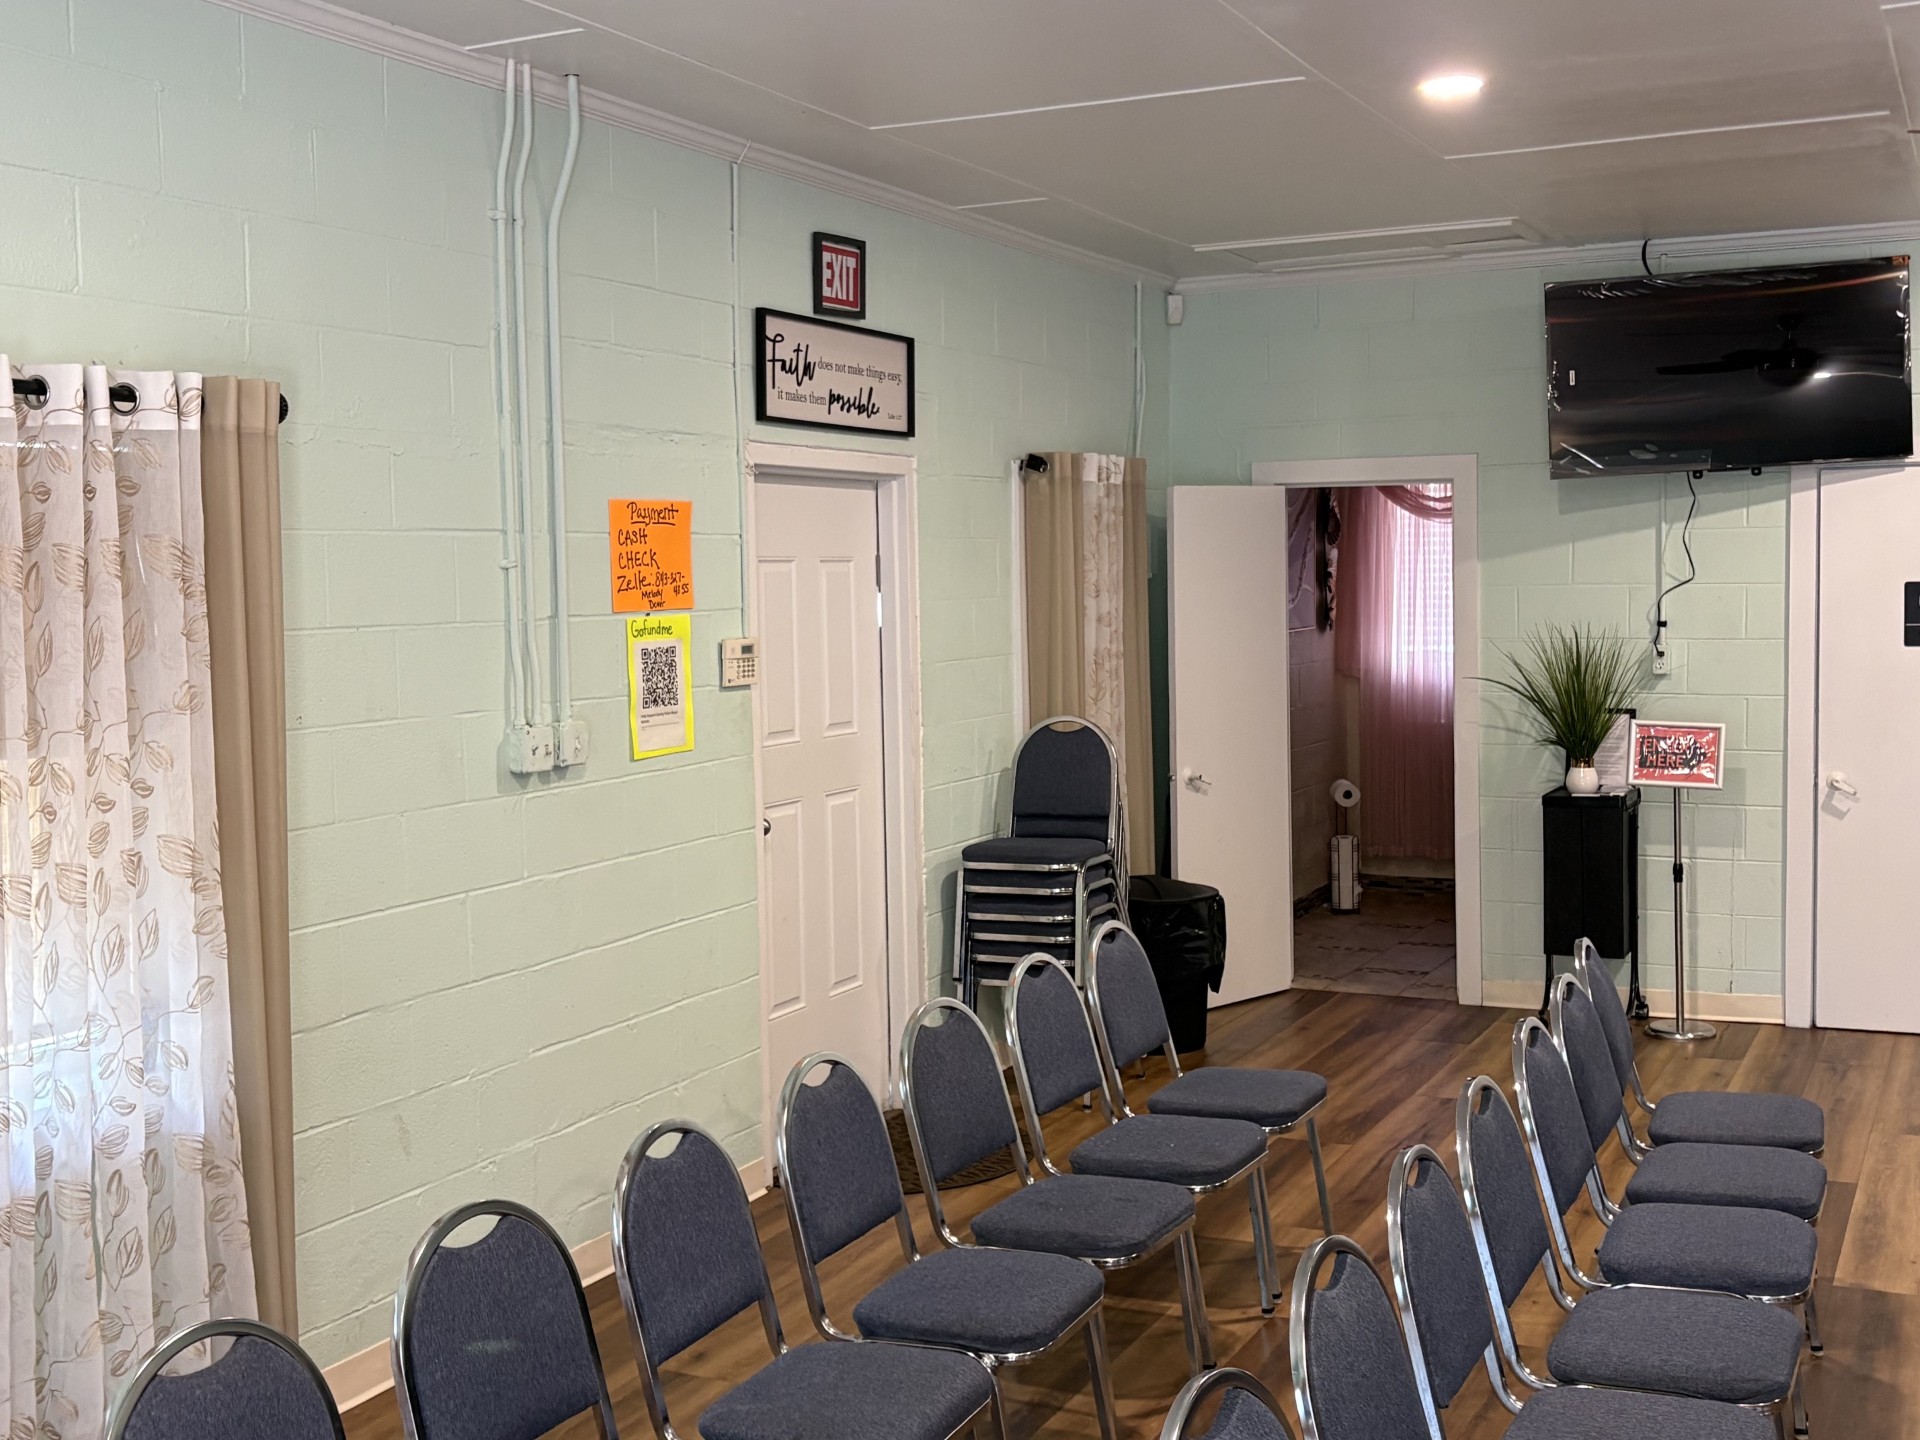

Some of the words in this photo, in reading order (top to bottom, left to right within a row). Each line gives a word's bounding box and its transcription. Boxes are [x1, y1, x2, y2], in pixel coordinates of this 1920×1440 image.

[822, 251, 857, 302] EXIT
[765, 333, 816, 390] Faith
[817, 356, 834, 371] does
[835, 363, 846, 374] not
[847, 363, 865, 377] make
[866, 365, 887, 383] things
[777, 386, 784, 400] it
[785, 389, 808, 403] makes
[809, 391, 827, 406] them
[627, 502, 679, 527] Payment
[618, 528, 648, 547] CASH
[618, 548, 660, 570] CHECK
[1646, 753, 1685, 768] HERE
